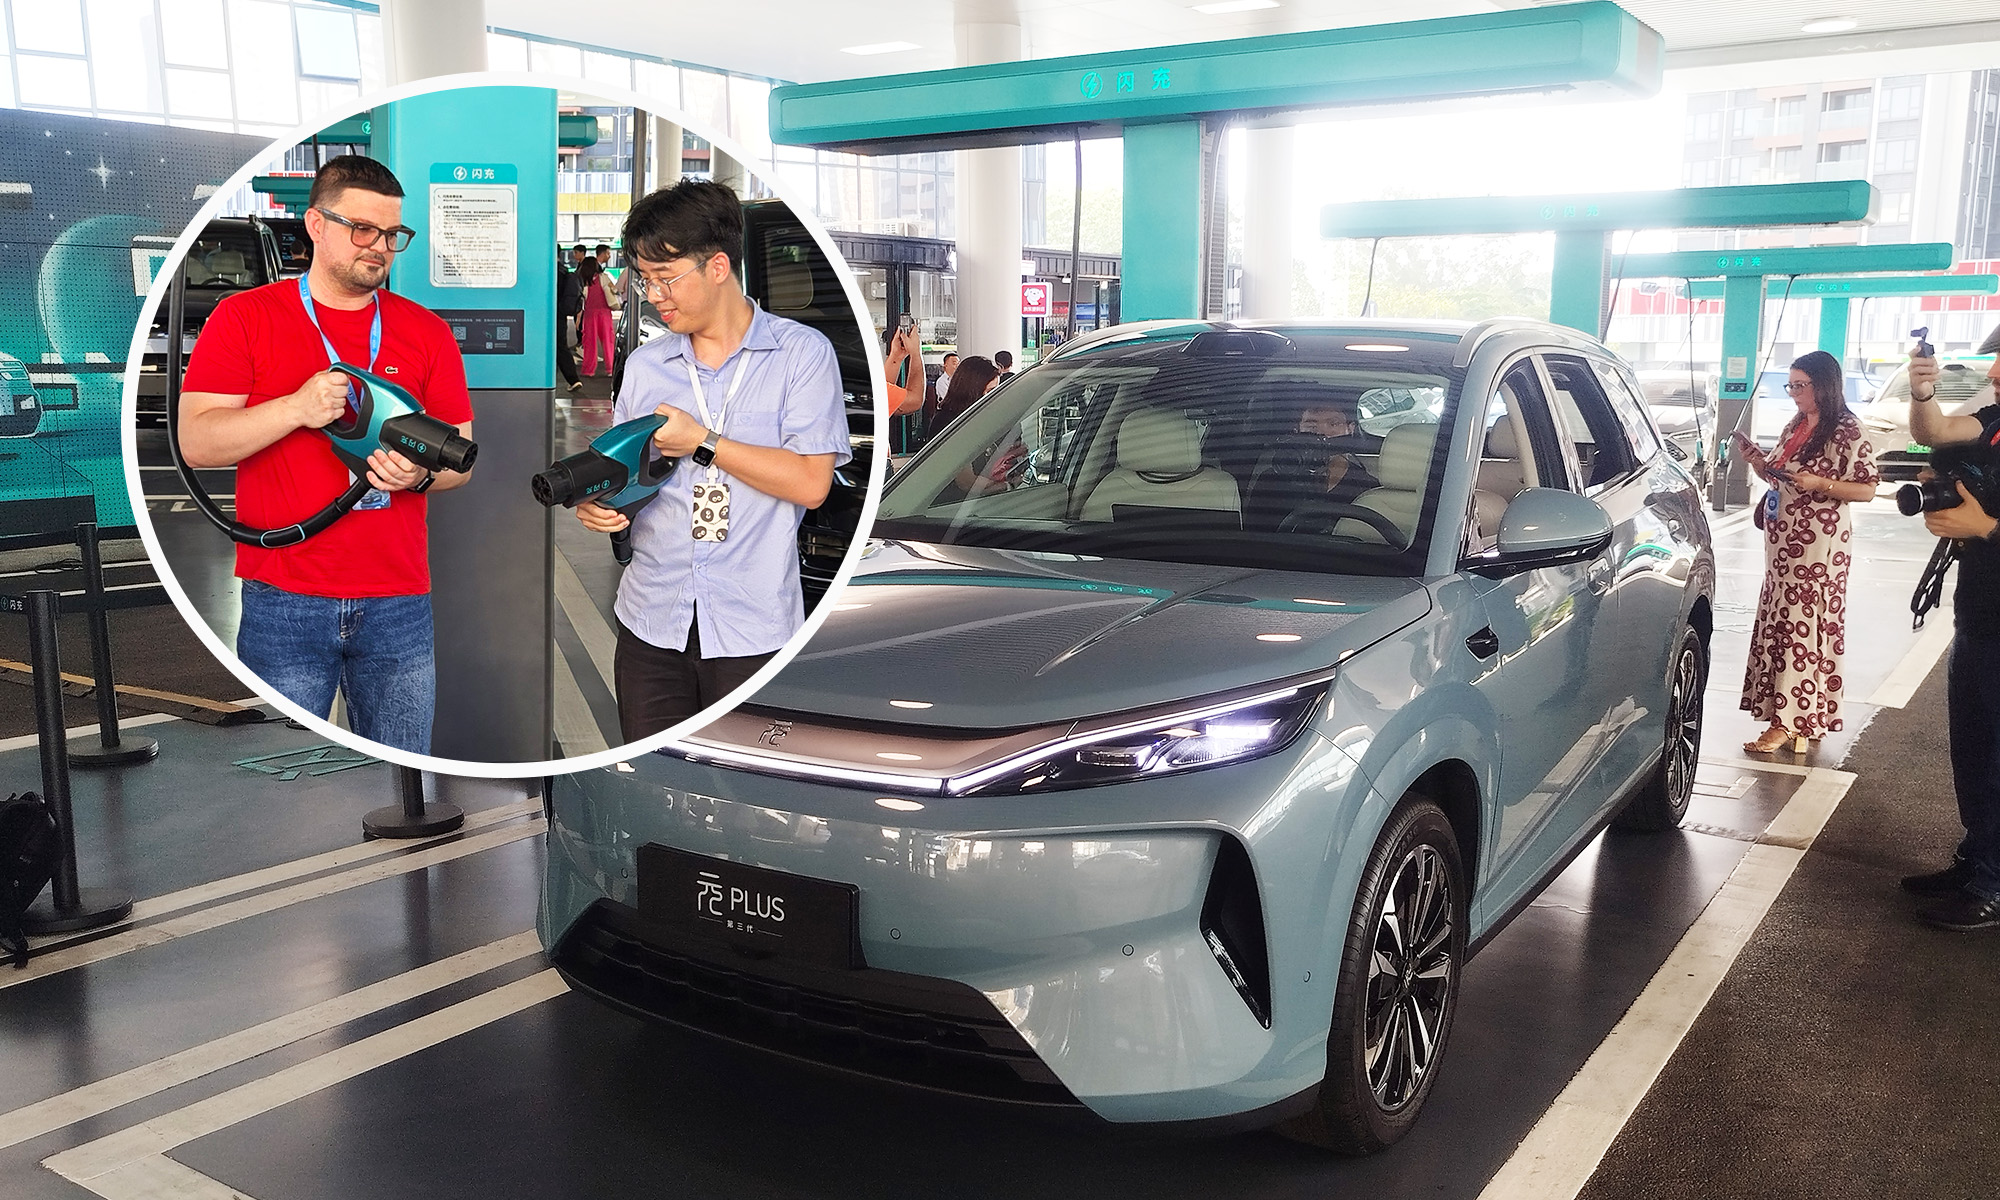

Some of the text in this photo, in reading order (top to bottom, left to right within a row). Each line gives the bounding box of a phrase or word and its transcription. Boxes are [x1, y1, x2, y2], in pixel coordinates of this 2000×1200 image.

[1117, 66, 1171, 93] 闪充
[471, 168, 495, 179] 闪充
[1563, 205, 1599, 217] 闪充
[1734, 257, 1761, 266] 闪充
[400, 435, 417, 449] 闪充
[10, 599, 23, 610] 闪充
[730, 886, 785, 922] PLUS
[726, 919, 754, 934] 第三代
